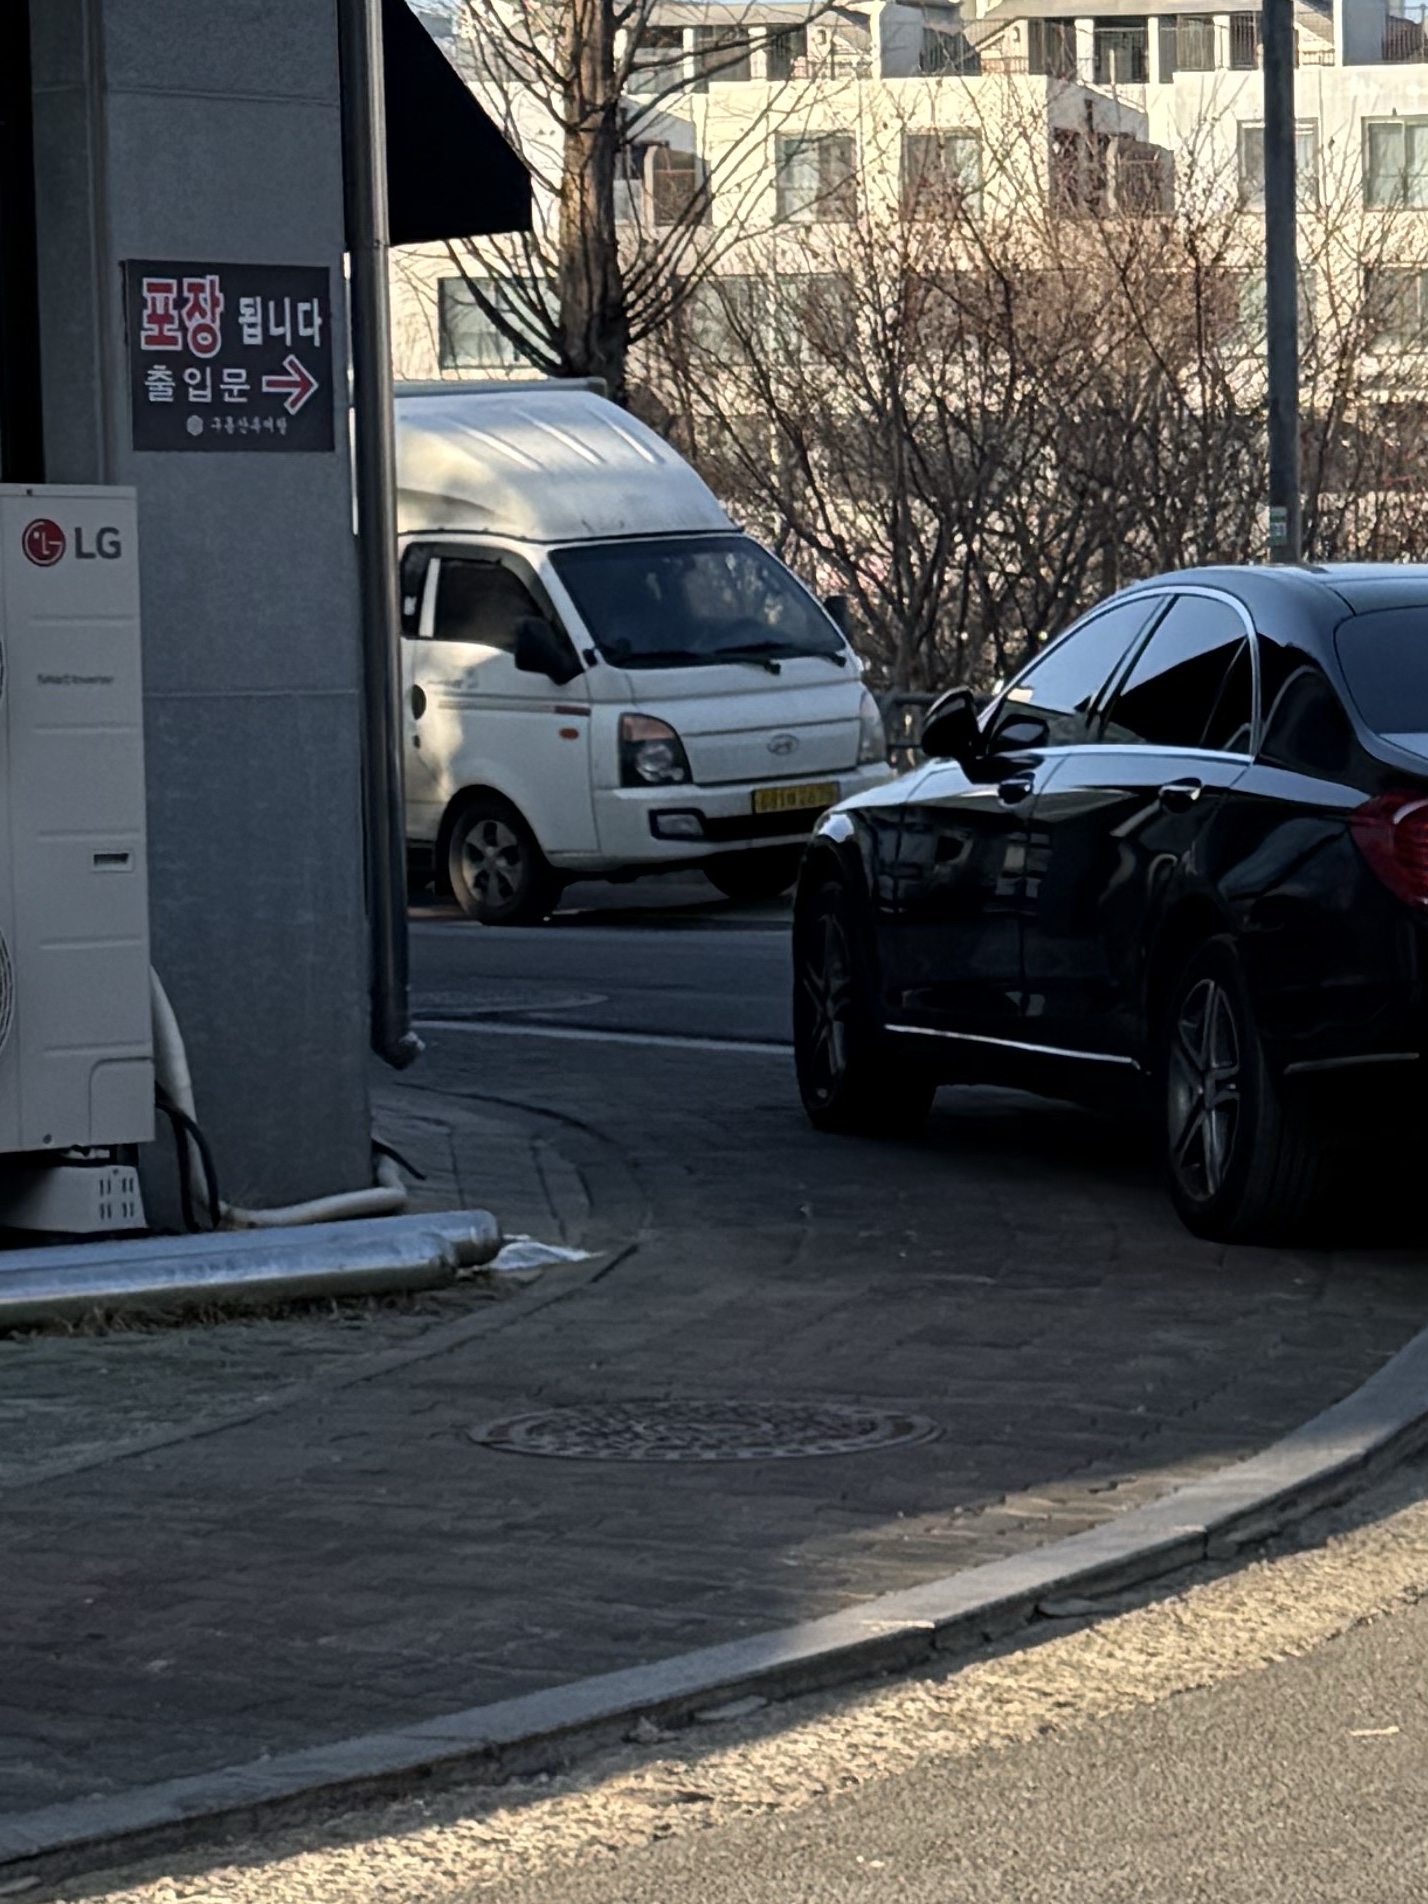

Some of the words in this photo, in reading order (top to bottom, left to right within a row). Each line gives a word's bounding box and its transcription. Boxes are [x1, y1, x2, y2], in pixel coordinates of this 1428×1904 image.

[140, 275, 225, 359] 포장
[238, 296, 323, 347] 됩니다
[144, 364, 251, 403] 출입문
[74, 526, 123, 560] LG
